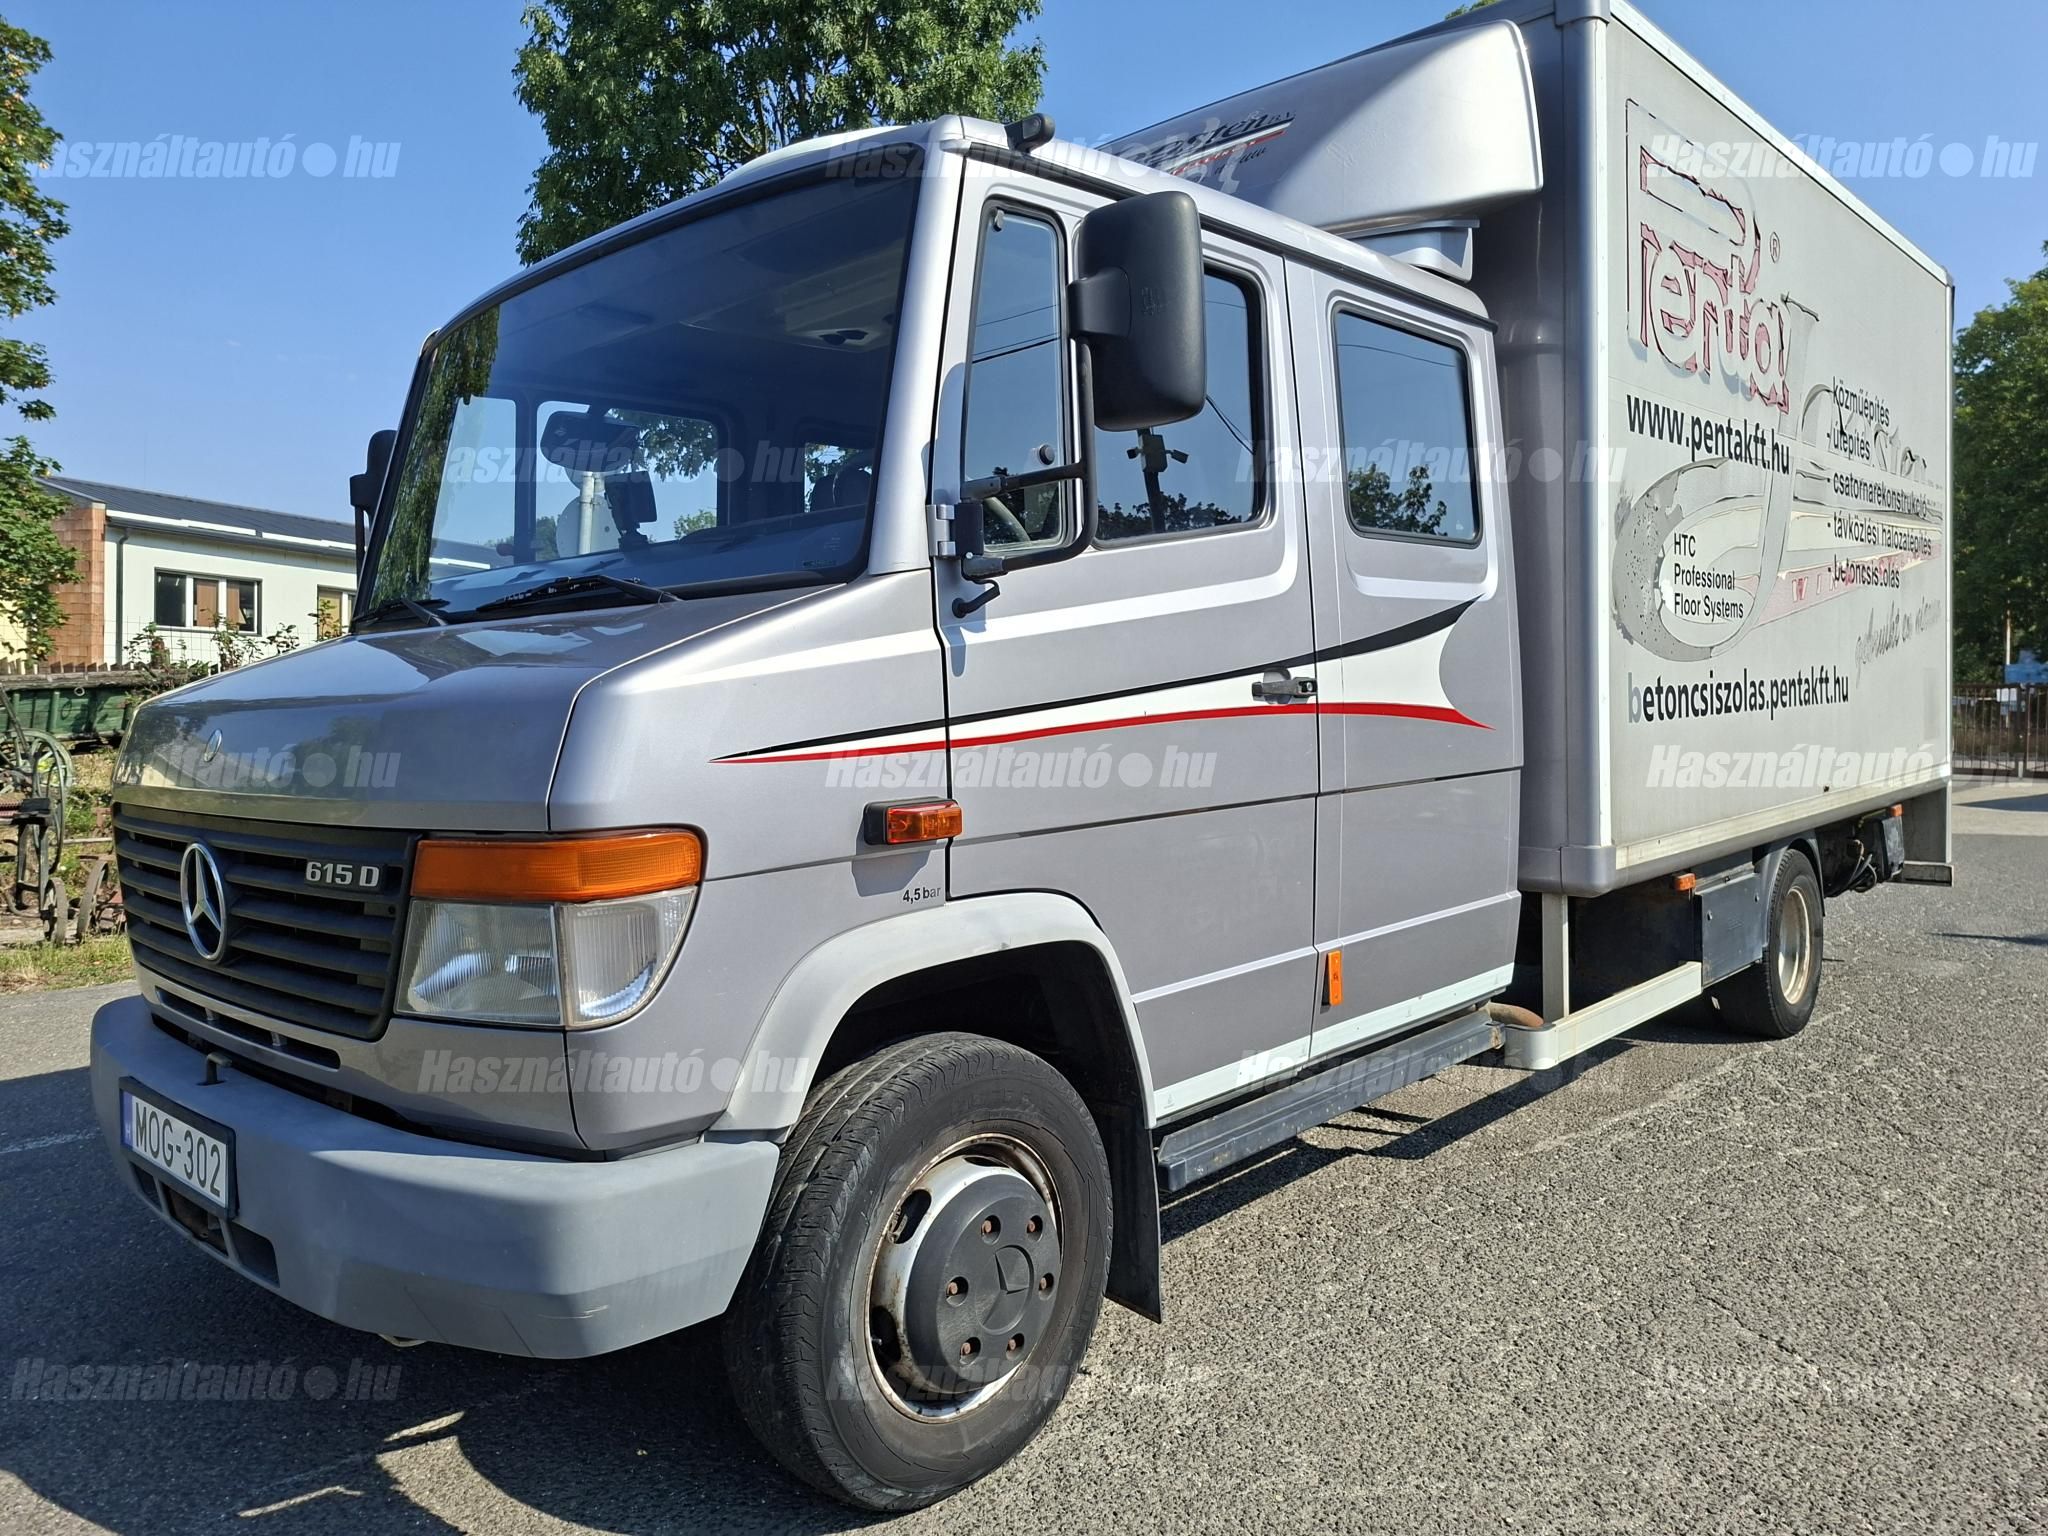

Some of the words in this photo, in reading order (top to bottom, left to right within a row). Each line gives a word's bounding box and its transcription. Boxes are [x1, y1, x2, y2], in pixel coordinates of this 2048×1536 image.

[1626, 394, 1790, 475] www.pentakft.hu
[1673, 532, 1696, 558] HTC
[1674, 562, 1735, 590] Professional
[1674, 592, 1701, 616] Floor
[1704, 595, 1744, 623] Systems
[1628, 665, 1849, 723] betoncsiszolas.pentakft.hu
[306, 861, 353, 885] 615
[359, 865, 380, 887] D
[903, 888, 921, 904] 4,5
[922, 887, 941, 899] bar
[136, 1102, 221, 1197] MOG-302
